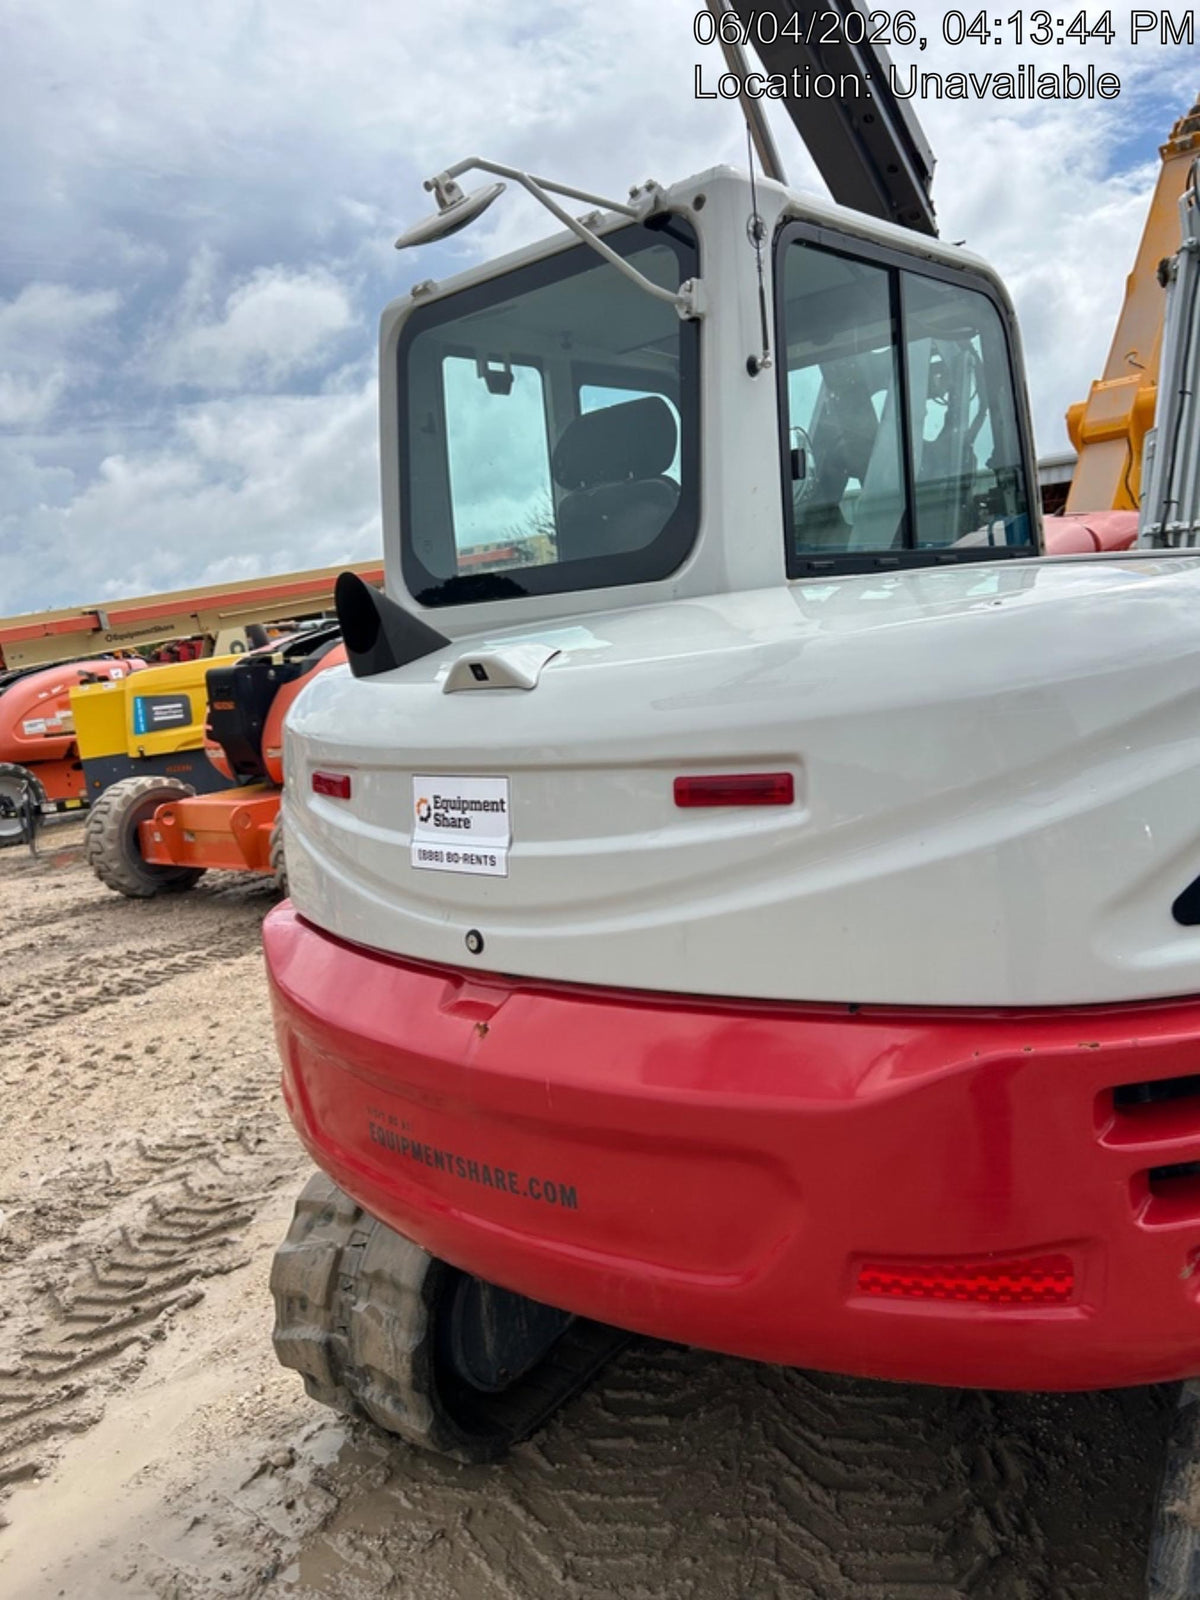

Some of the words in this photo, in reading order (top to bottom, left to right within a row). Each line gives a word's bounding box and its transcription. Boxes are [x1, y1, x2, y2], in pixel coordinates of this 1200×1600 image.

[433, 795, 506, 814] Equipment
[433, 812, 471, 829] Share
[369, 1121, 578, 1209] EQUIPMENTSHARE.COM
